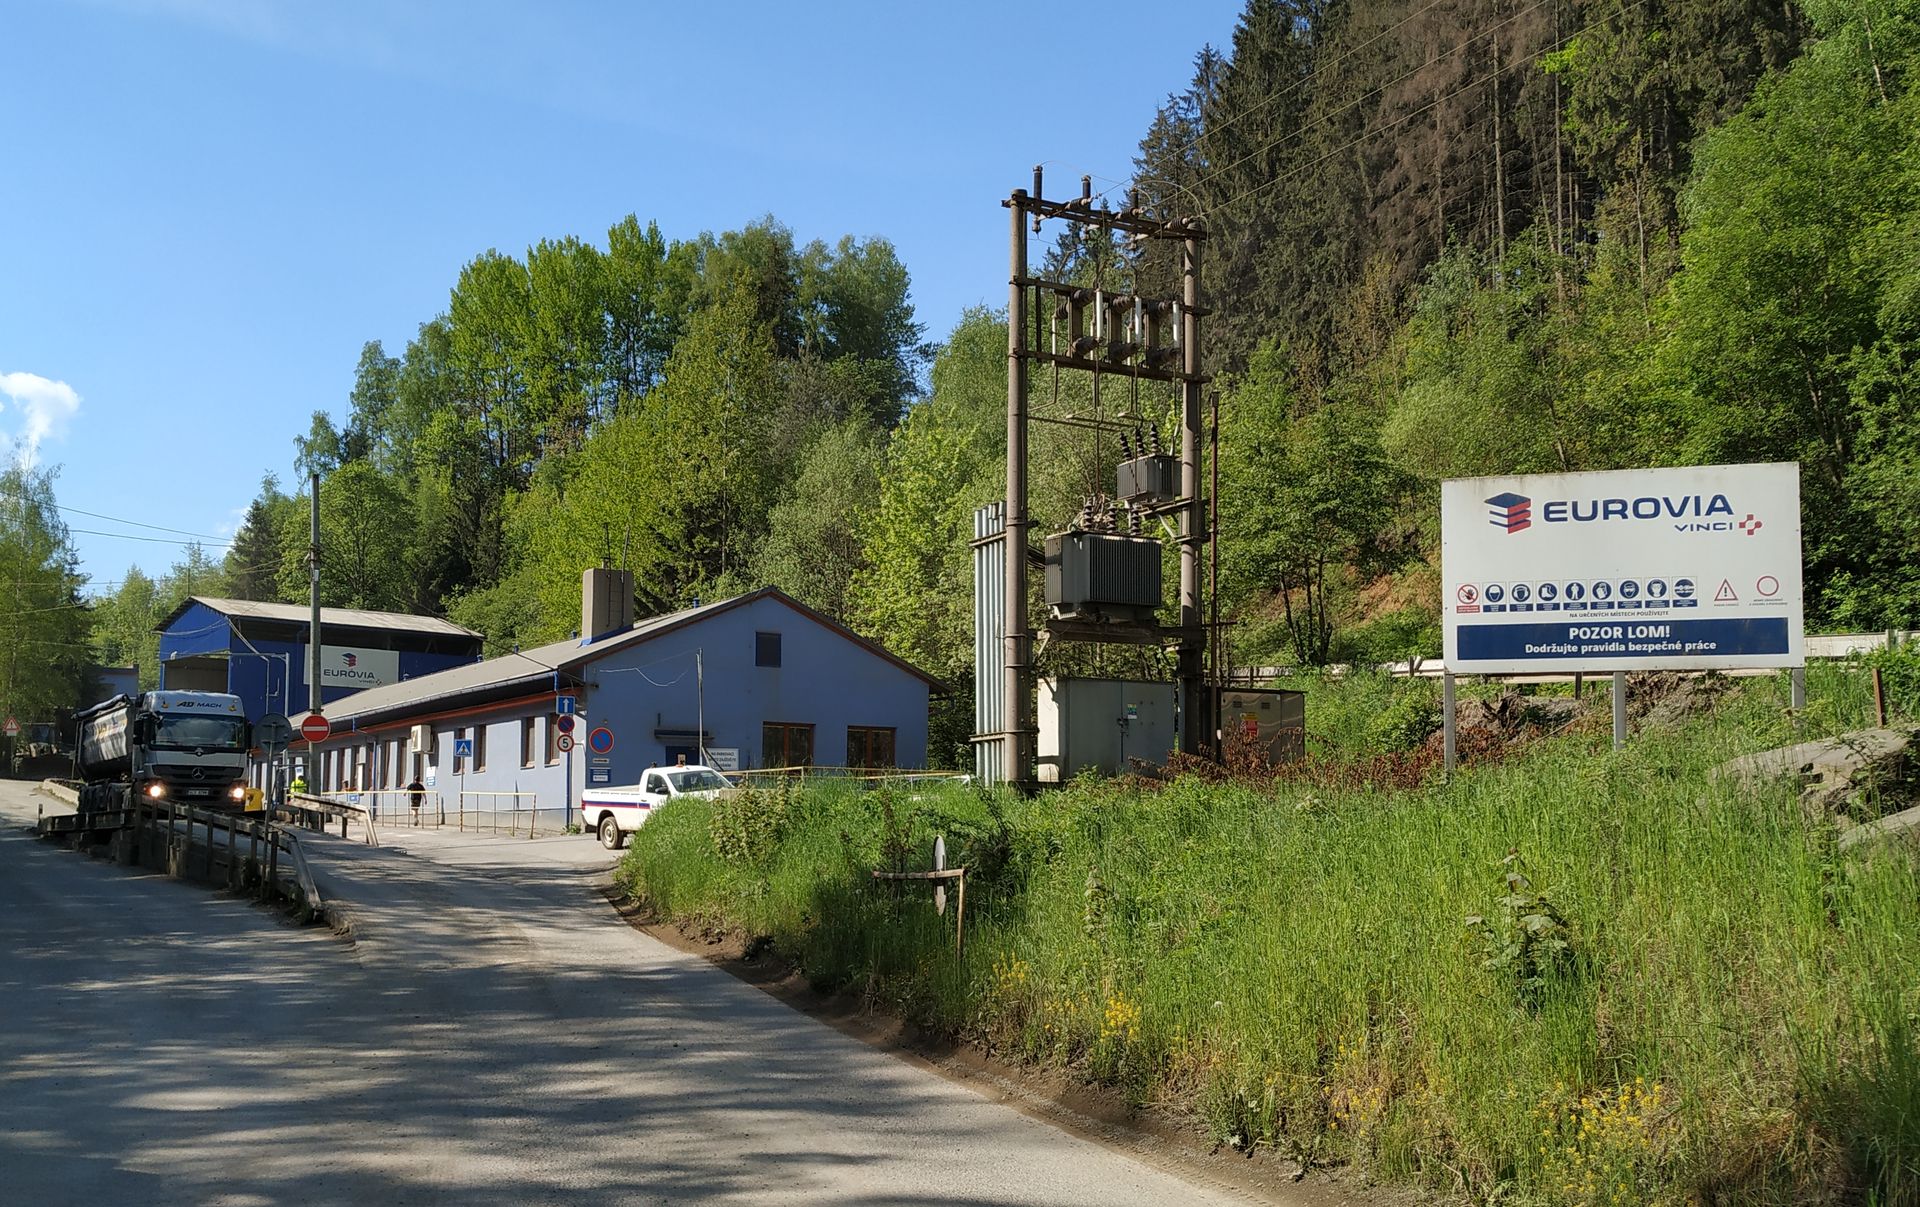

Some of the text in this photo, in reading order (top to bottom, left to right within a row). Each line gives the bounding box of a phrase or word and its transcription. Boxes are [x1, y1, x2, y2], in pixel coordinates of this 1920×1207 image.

[1543, 494, 1734, 522] EUROVIA
[1674, 522, 1733, 532] VINCI
[1579, 610, 1609, 618] URČENÝCH
[1636, 609, 1669, 617] POUŽÍVEJTE
[1569, 625, 1671, 640] POZOR LOM!
[1525, 640, 1717, 655] Dodržujte pravidla bezpečné práce
[323, 668, 375, 679] EUROVIA
[562, 737, 569, 749] 5
